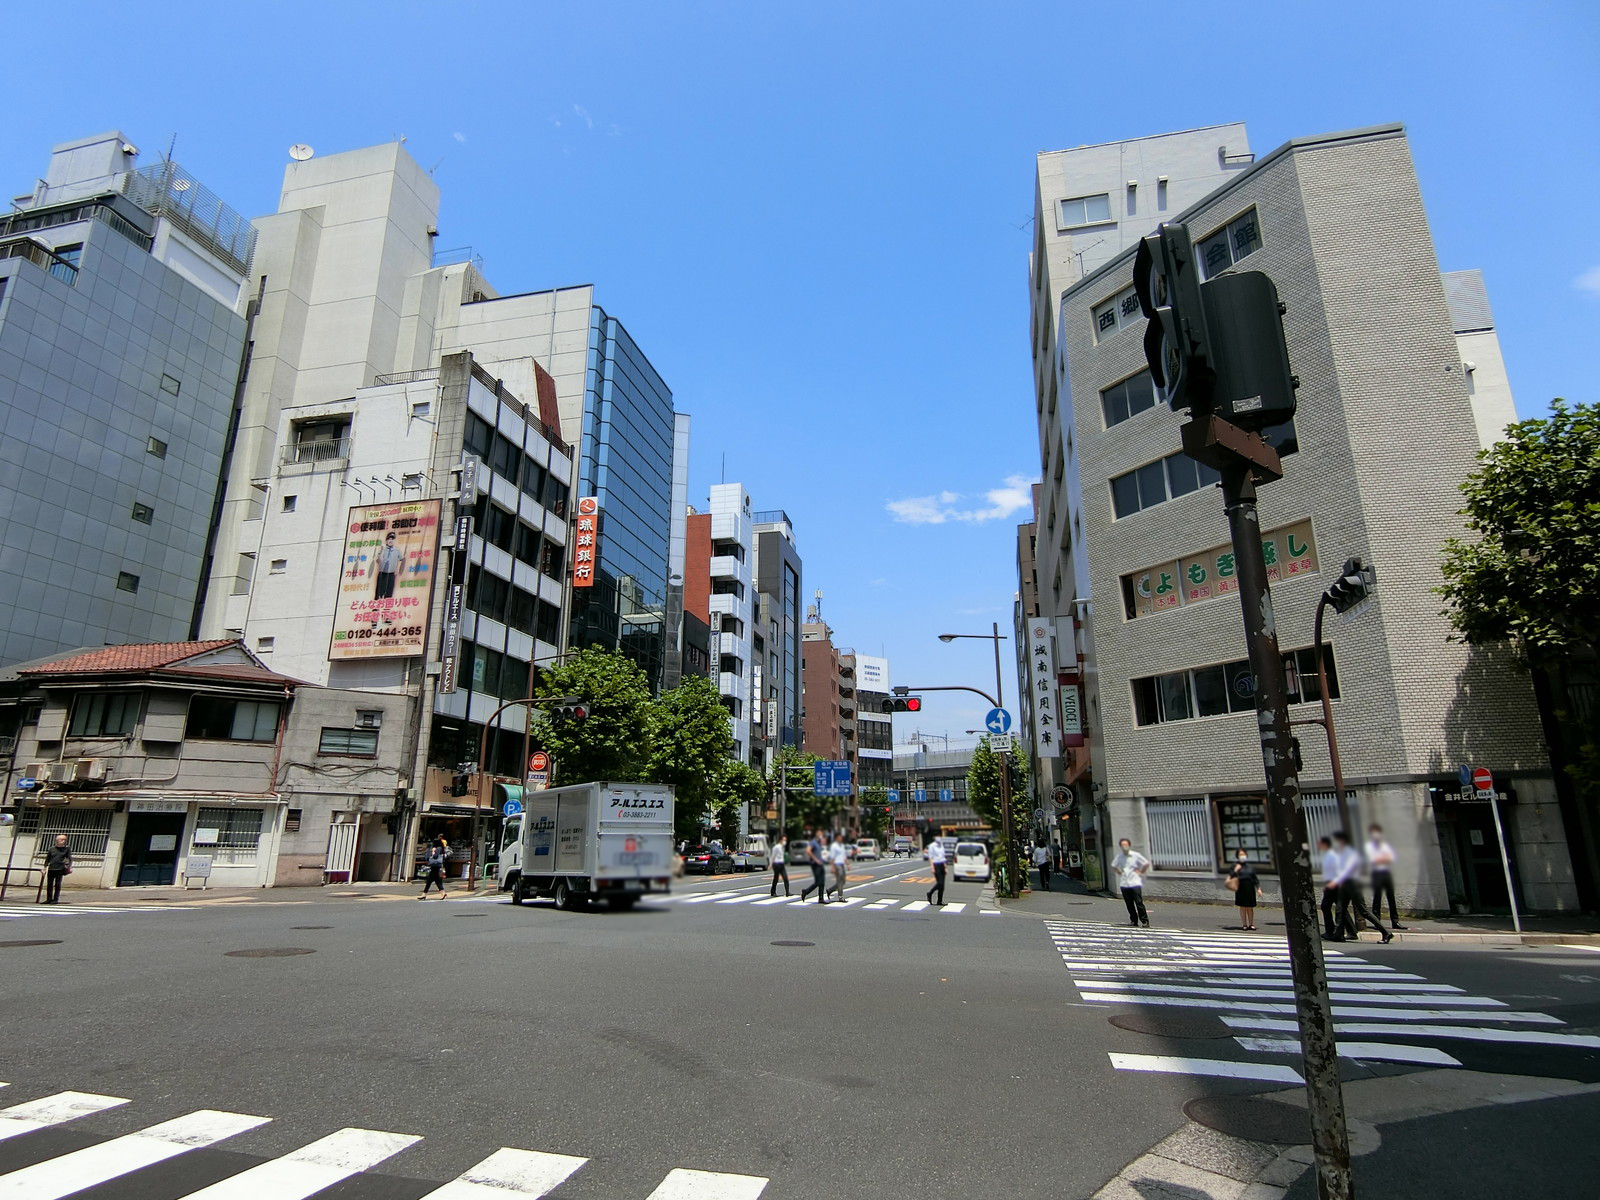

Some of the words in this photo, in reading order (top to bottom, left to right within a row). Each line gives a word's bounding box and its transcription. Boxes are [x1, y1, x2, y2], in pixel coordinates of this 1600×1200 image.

[463, 460, 475, 499] 金子ビル
[360, 520, 390, 532] 便利屋!
[575, 518, 594, 579] 琉球銀行
[1189, 585, 1210, 600] 韓国
[1287, 557, 1313, 575] 薬草
[350, 597, 420, 610] どんなお困り事も
[347, 626, 422, 640] 0120-444-365
[1034, 643, 1054, 747] 城南信用金庫
[1065, 694, 1077, 722] VELOCE
[610, 798, 665, 809] アールエスエス
